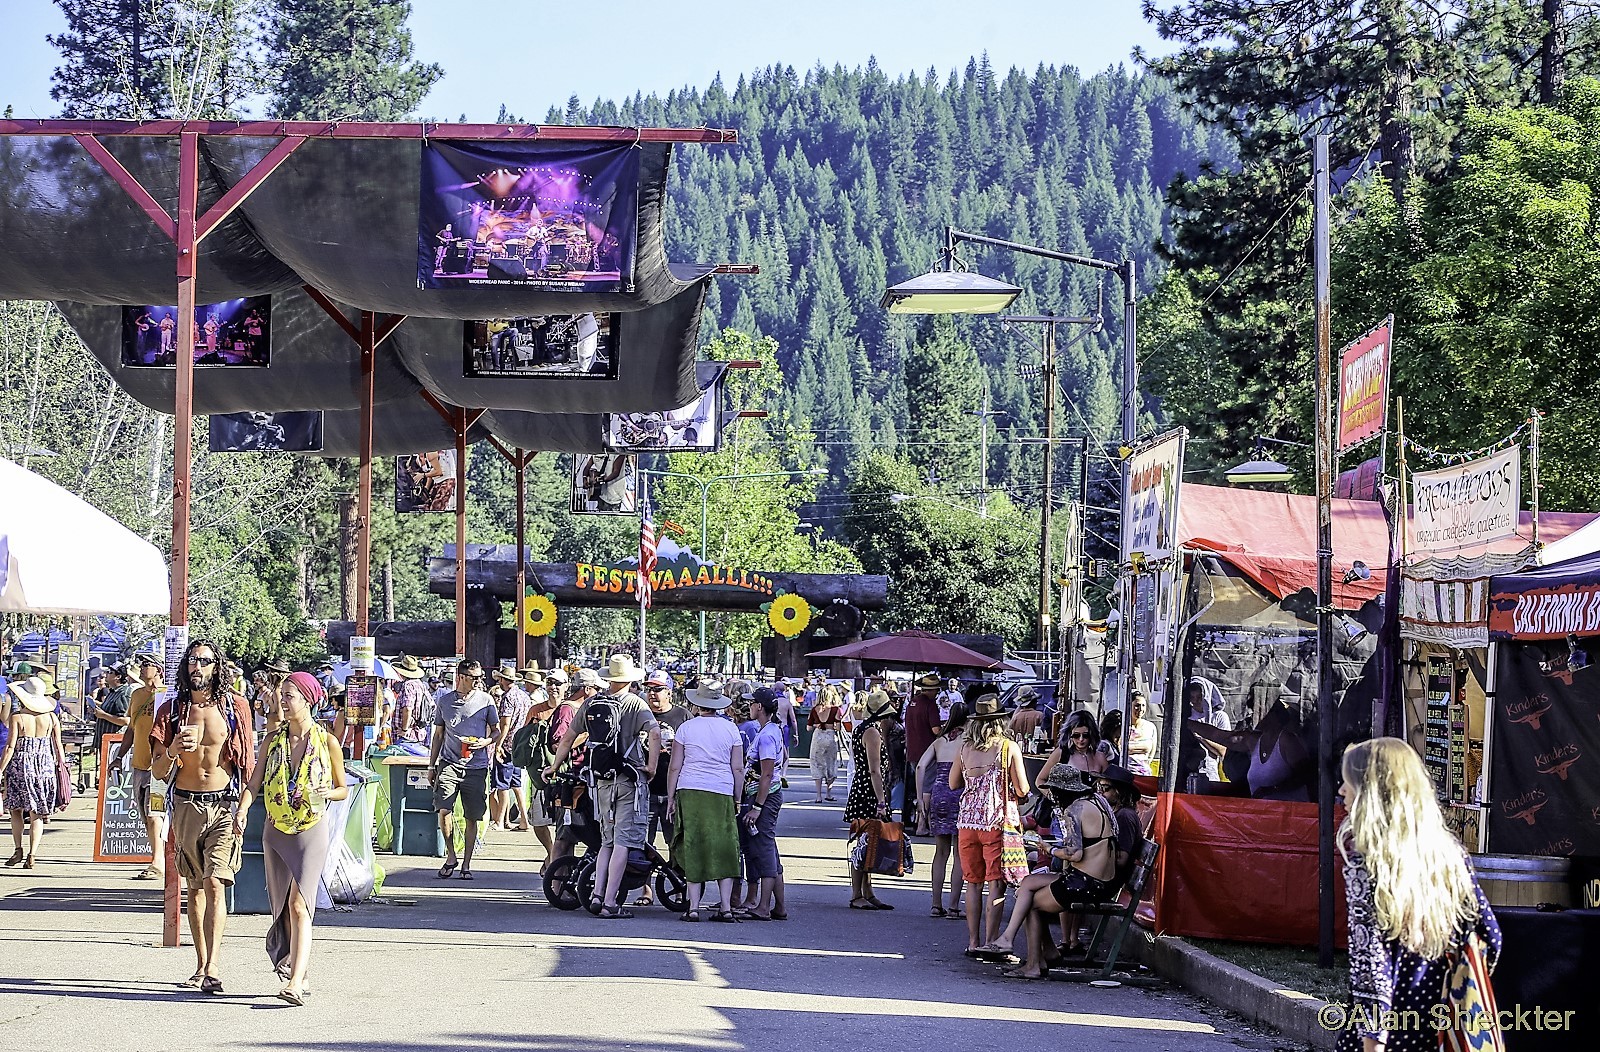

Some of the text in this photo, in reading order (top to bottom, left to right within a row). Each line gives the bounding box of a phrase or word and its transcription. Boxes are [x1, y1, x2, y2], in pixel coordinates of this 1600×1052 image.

[575, 562, 773, 596] FESTVAAALLL!!!
[1512, 591, 1590, 634] CALIFORNIA
[993, 673, 1007, 681] 25
[1505, 692, 1549, 717] Kinder's
[1534, 742, 1578, 767] Kinder's
[1501, 787, 1545, 813] Kinder's
[101, 840, 109, 854] A
